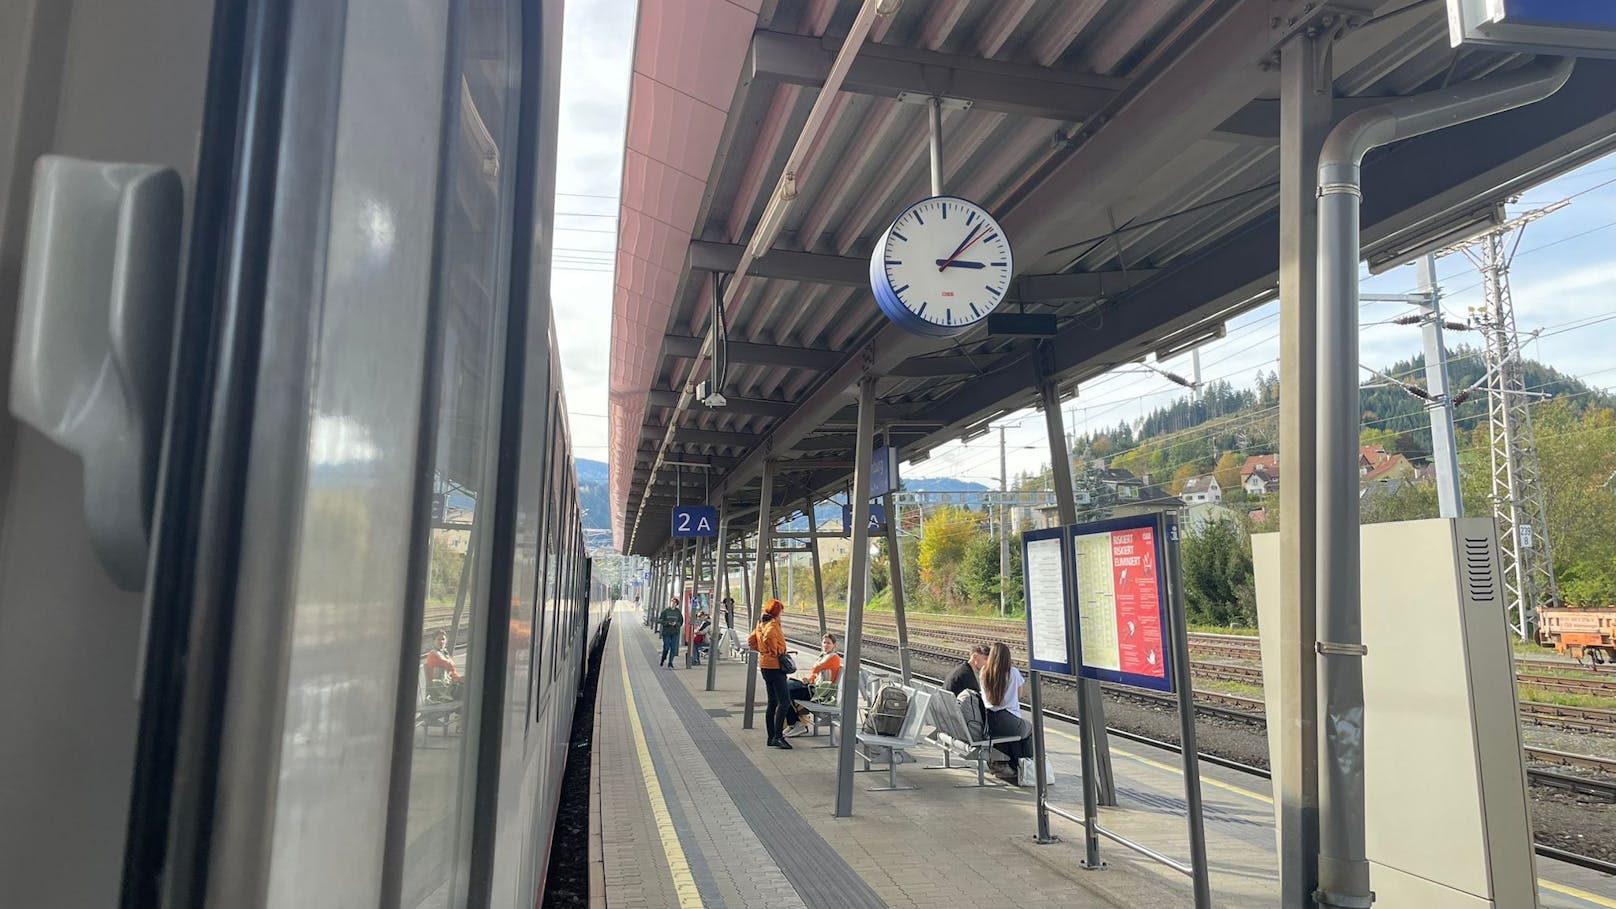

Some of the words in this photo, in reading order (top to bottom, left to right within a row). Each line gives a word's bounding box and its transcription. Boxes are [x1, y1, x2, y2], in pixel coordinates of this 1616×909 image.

[678, 512, 690, 532] 2
[697, 516, 710, 531] A
[867, 514, 880, 529] A
[1520, 526, 1531, 536] 239
[1524, 536, 1529, 545] 8
